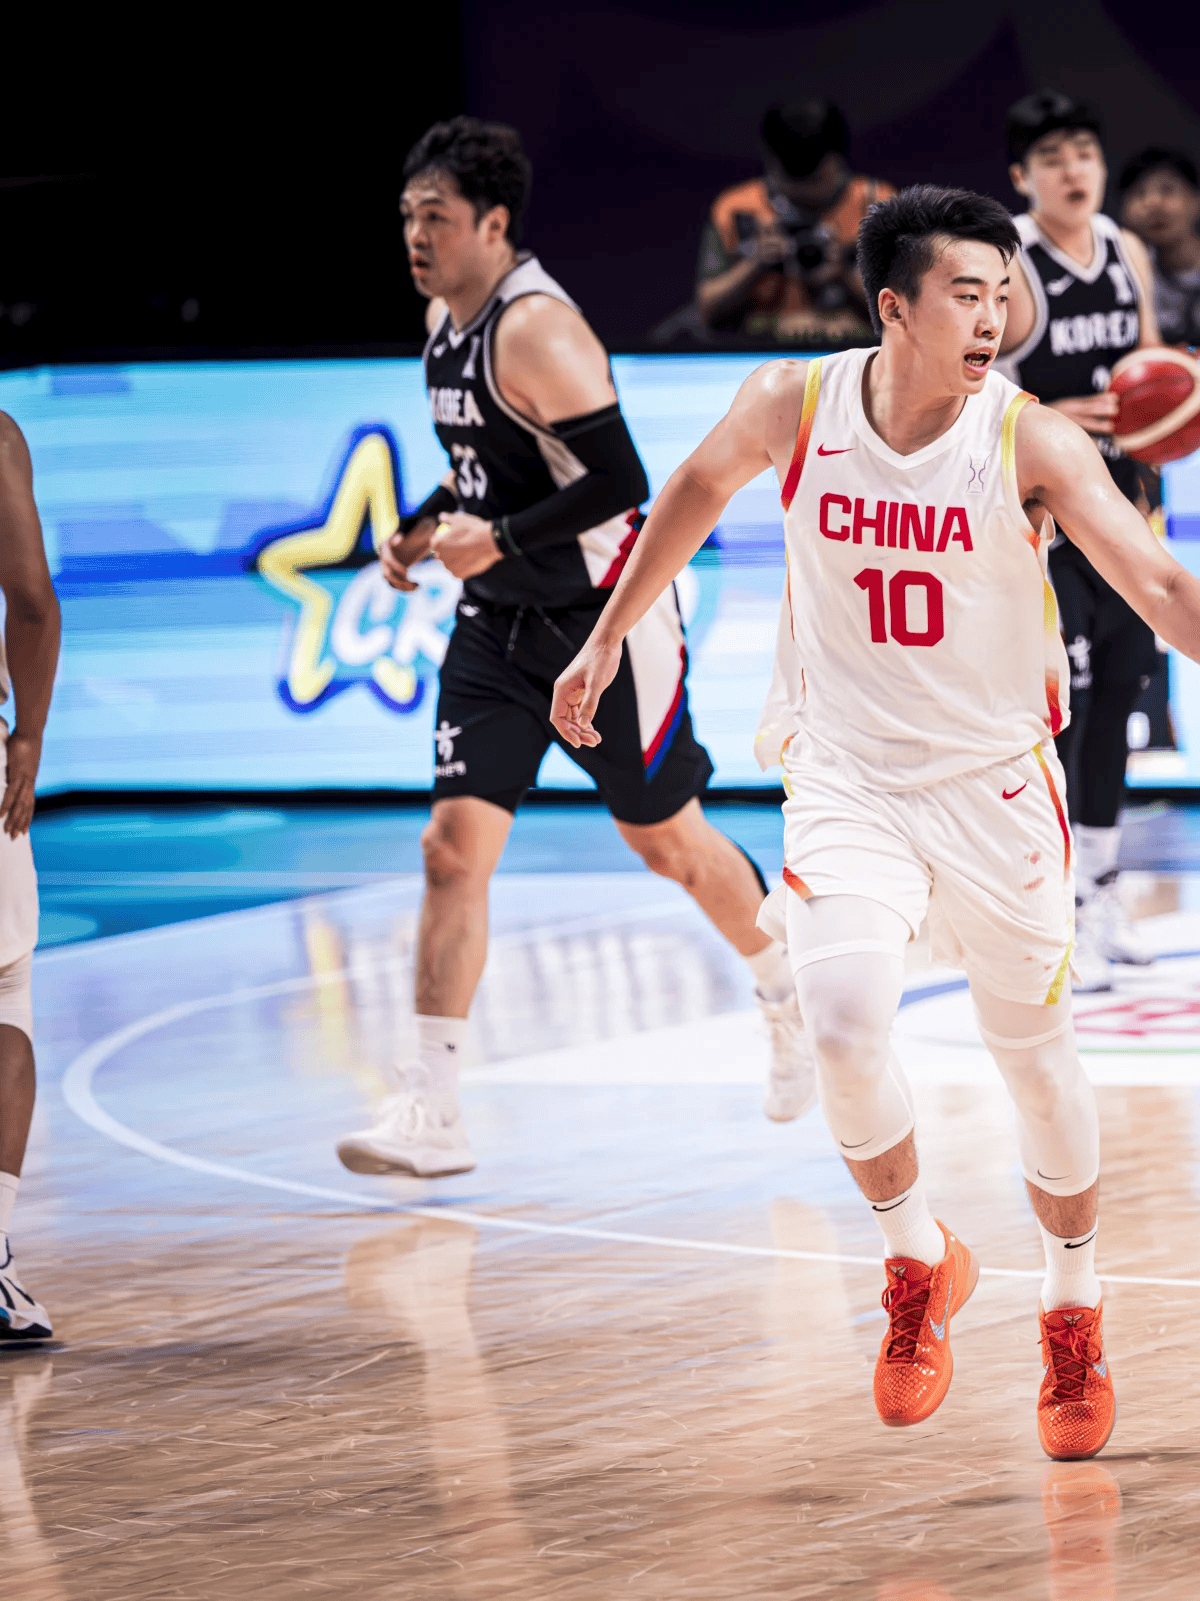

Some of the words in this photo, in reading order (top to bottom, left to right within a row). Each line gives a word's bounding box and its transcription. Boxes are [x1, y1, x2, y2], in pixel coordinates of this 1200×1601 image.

[451, 442, 488, 500] 33
[819, 492, 974, 553] CHINA
[853, 568, 944, 647] 10
